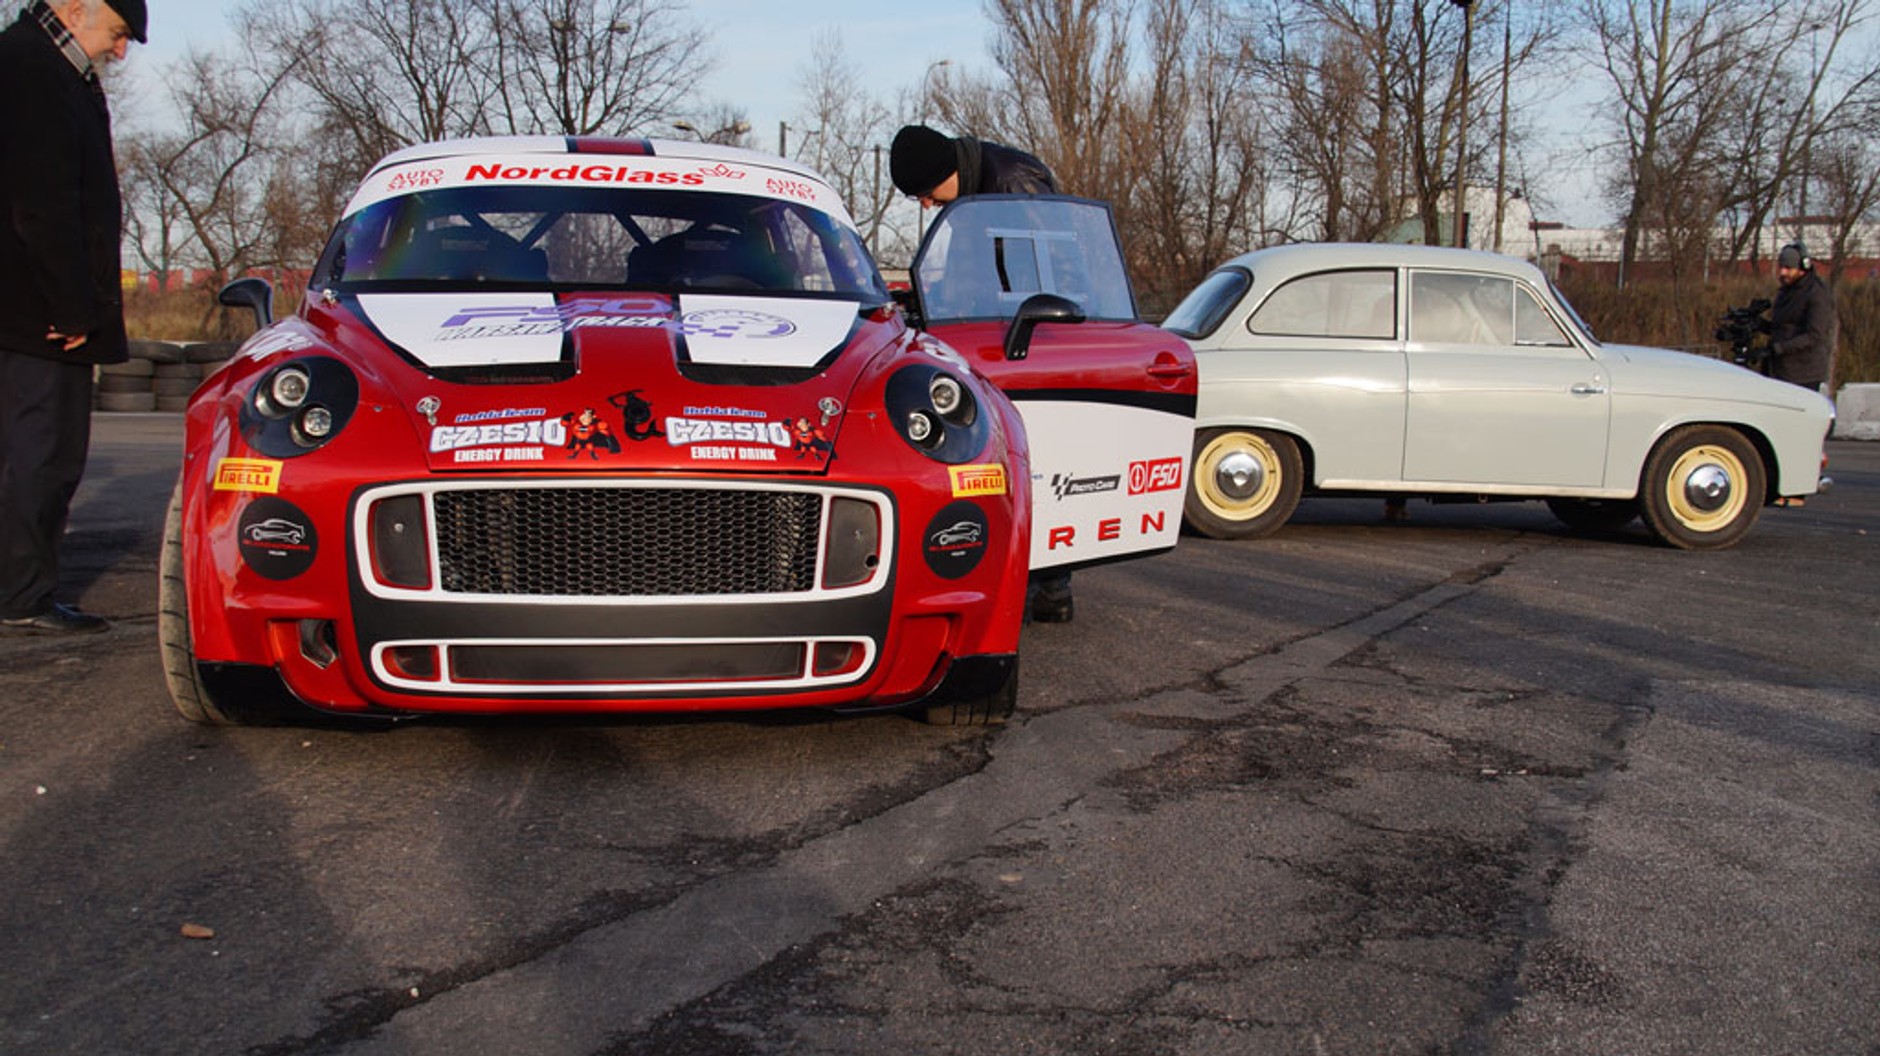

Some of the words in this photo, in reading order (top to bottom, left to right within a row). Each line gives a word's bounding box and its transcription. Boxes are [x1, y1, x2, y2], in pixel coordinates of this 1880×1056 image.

[386, 176, 442, 192] SZYBY
[393, 168, 445, 181] AUTO
[465, 164, 704, 186] NordGlass
[765, 177, 813, 195] AUTO
[430, 417, 567, 453] CZESIO
[665, 417, 792, 448] CZESIO
[454, 448, 502, 463] ENERGY
[503, 447, 545, 461] DRINK
[691, 446, 736, 460] ENERGY
[738, 448, 777, 461] DRINK
[219, 463, 274, 487] PIRELLI
[956, 468, 1003, 491] PIRELLI
[1146, 462, 1180, 490] FSO
